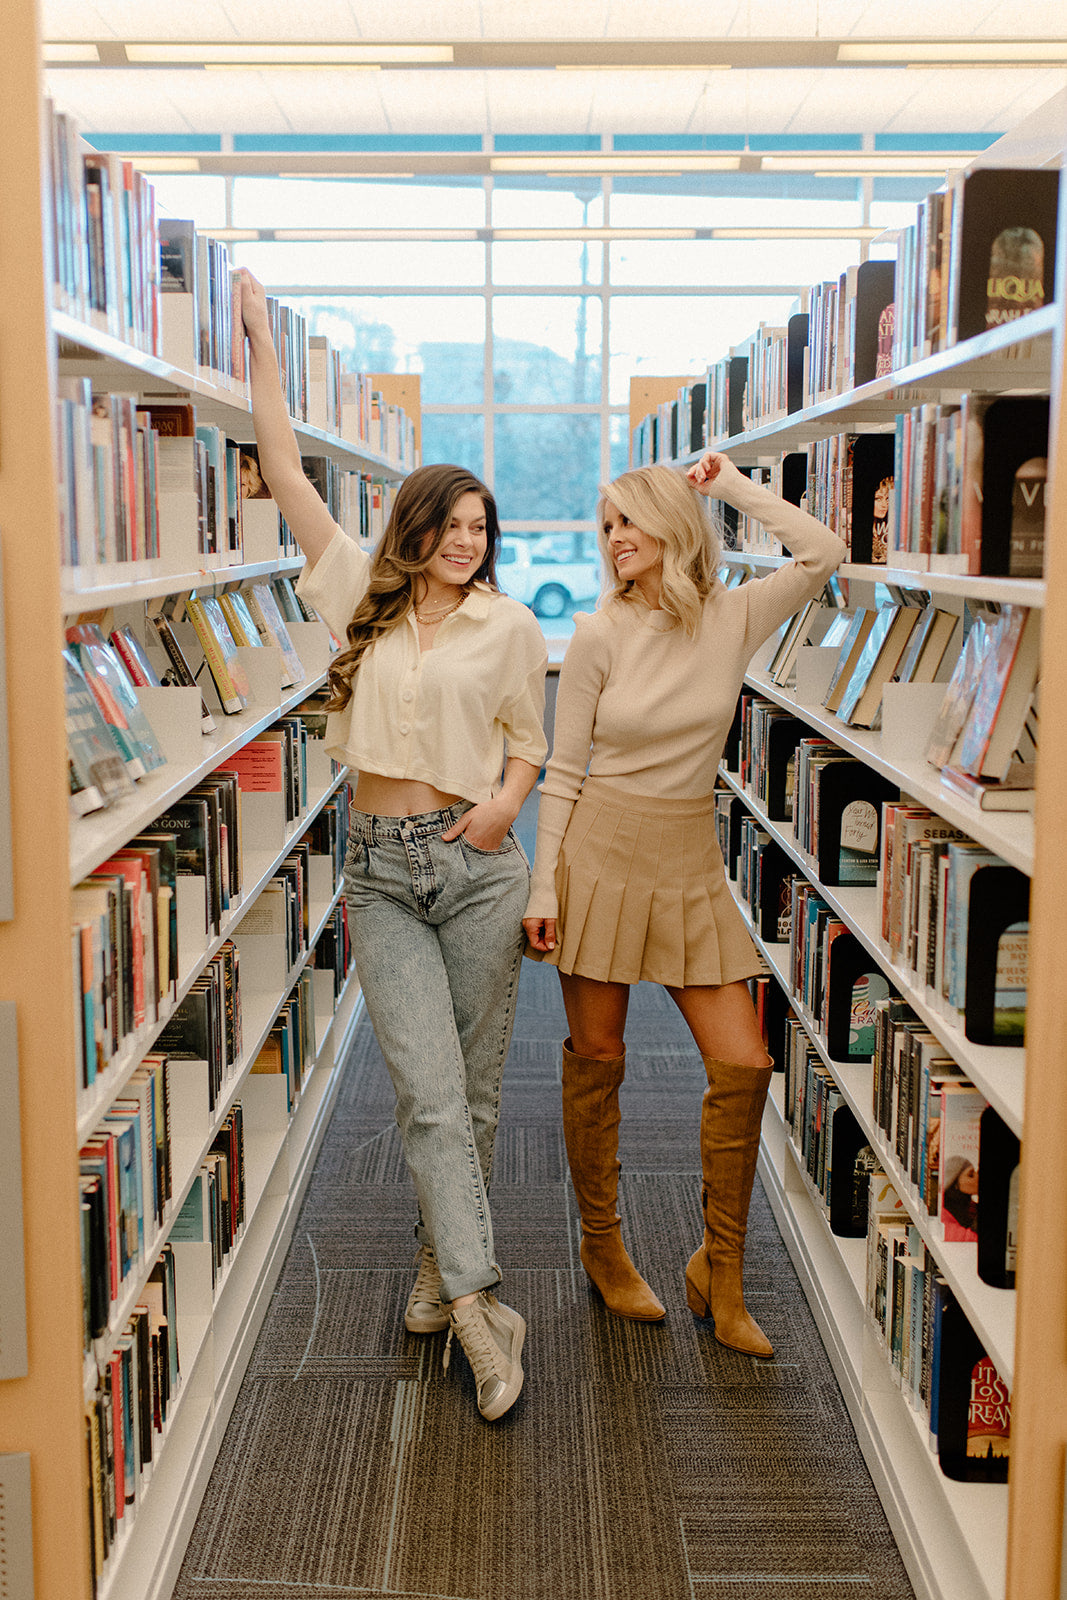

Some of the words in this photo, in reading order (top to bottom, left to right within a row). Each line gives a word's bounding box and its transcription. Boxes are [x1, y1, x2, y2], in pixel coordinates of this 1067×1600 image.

[207, 647, 218, 664] MINE
[221, 678, 234, 699] YOURS
[161, 819, 191, 829] GONE
[923, 1272, 931, 1306] VINCE
